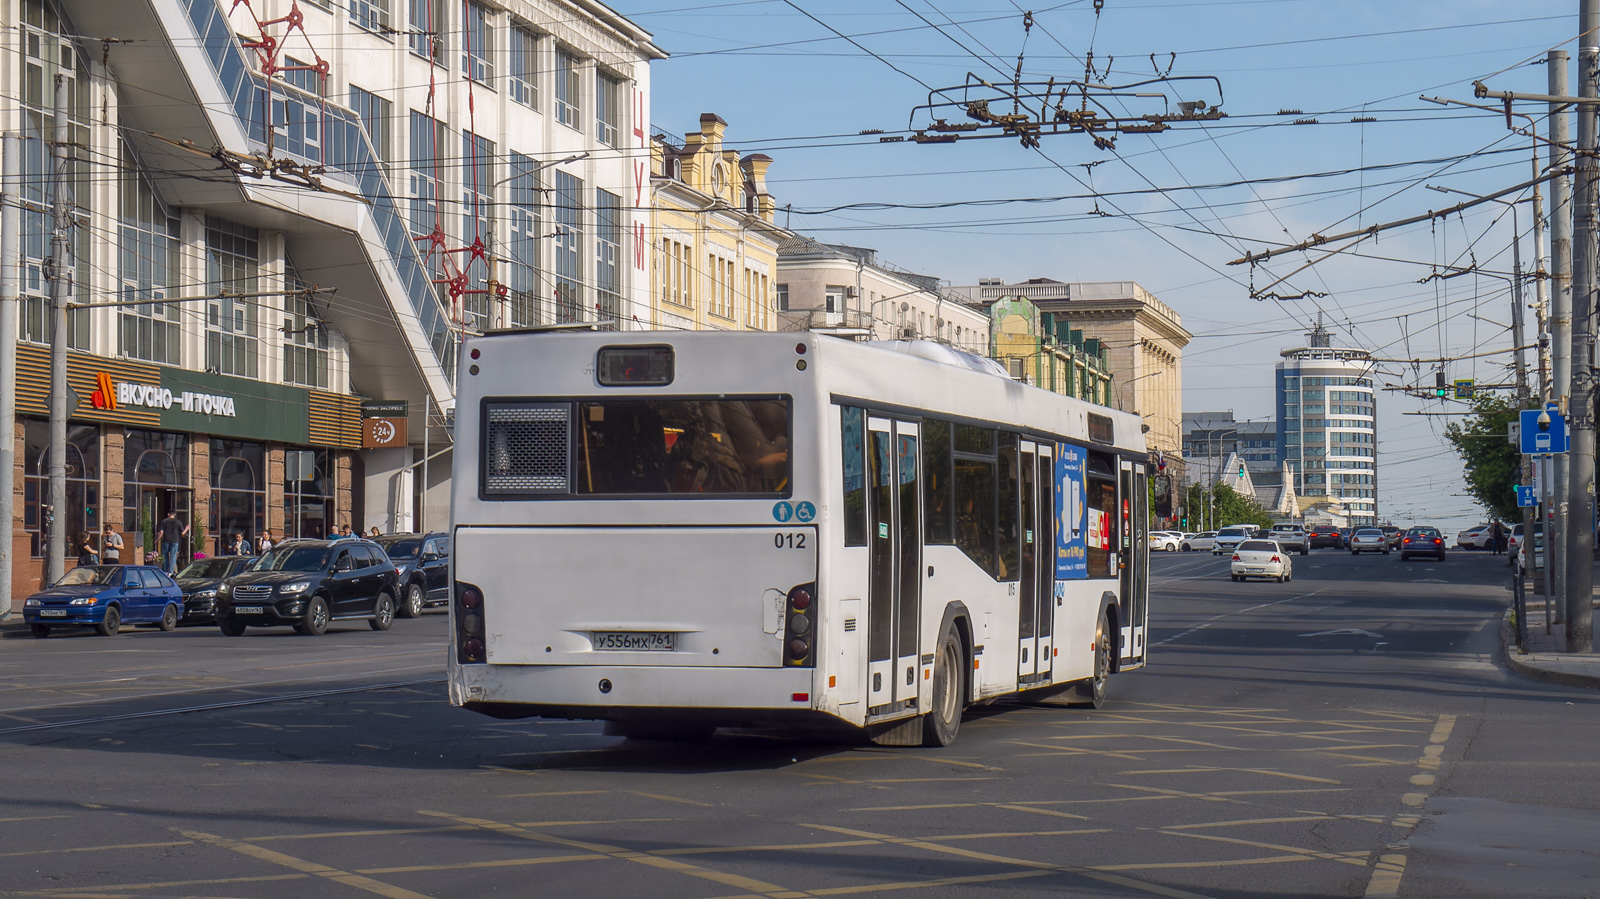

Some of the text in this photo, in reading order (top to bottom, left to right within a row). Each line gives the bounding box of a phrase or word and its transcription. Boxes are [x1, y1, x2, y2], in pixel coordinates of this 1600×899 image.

[633, 87, 645, 272] ЦУМ
[194, 392, 236, 417] ТОЧКА
[774, 532, 806, 549] 012
[599, 634, 670, 648] У556МХ 761
